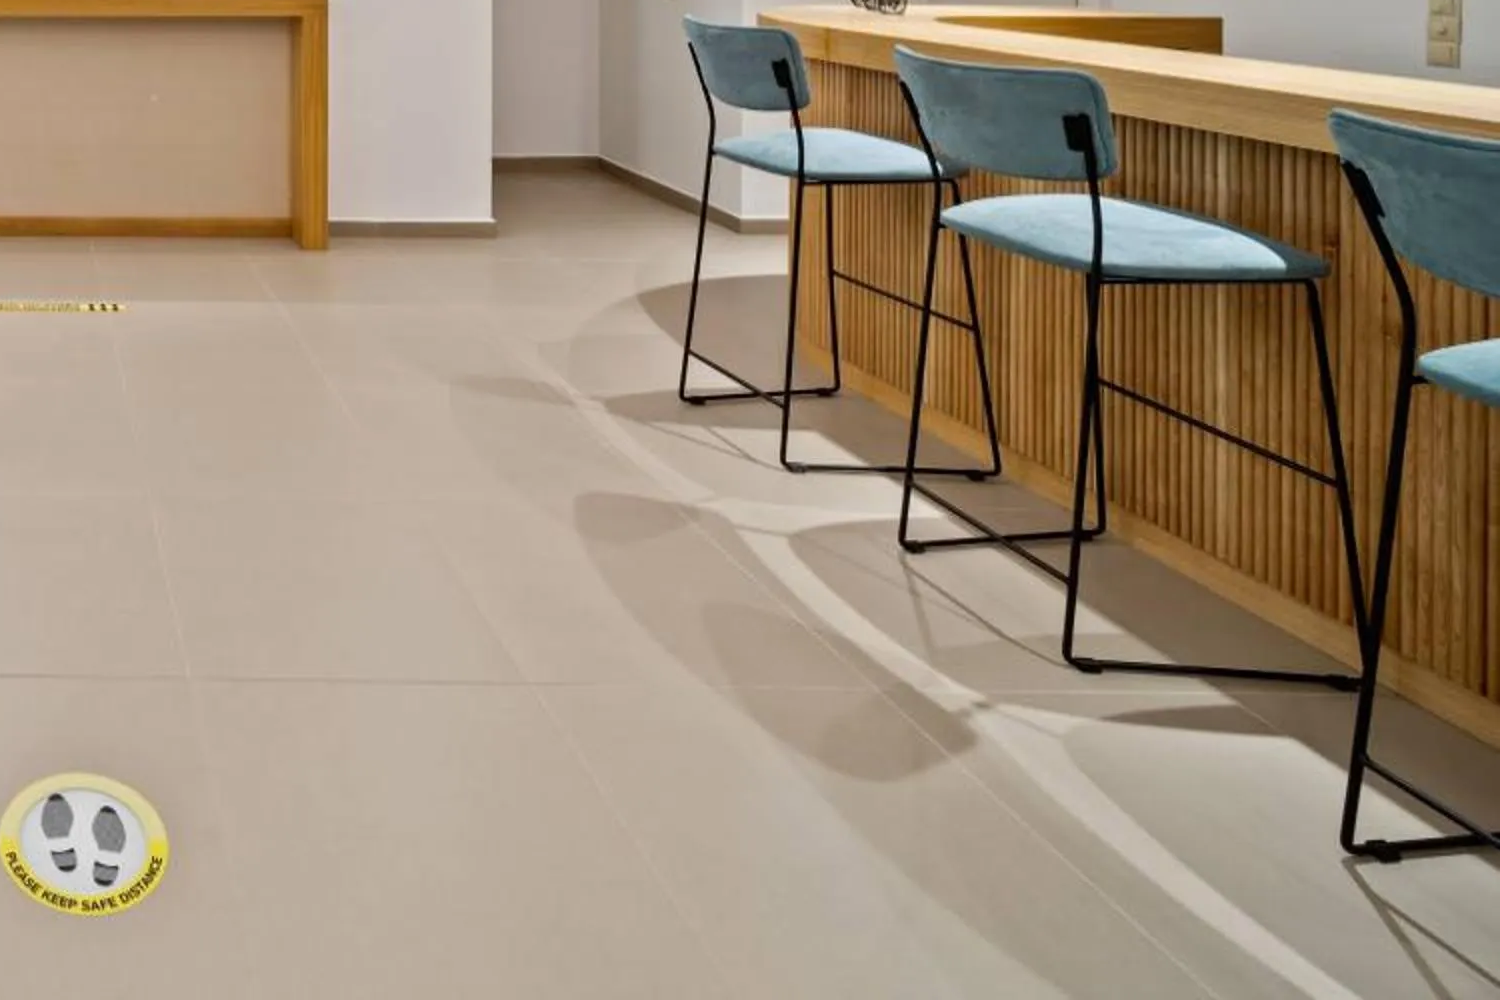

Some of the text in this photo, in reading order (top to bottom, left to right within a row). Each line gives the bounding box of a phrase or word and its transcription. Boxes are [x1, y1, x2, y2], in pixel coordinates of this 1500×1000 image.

[6, 851, 163, 912] PLEASE KEEP SAFE DISTANCE
